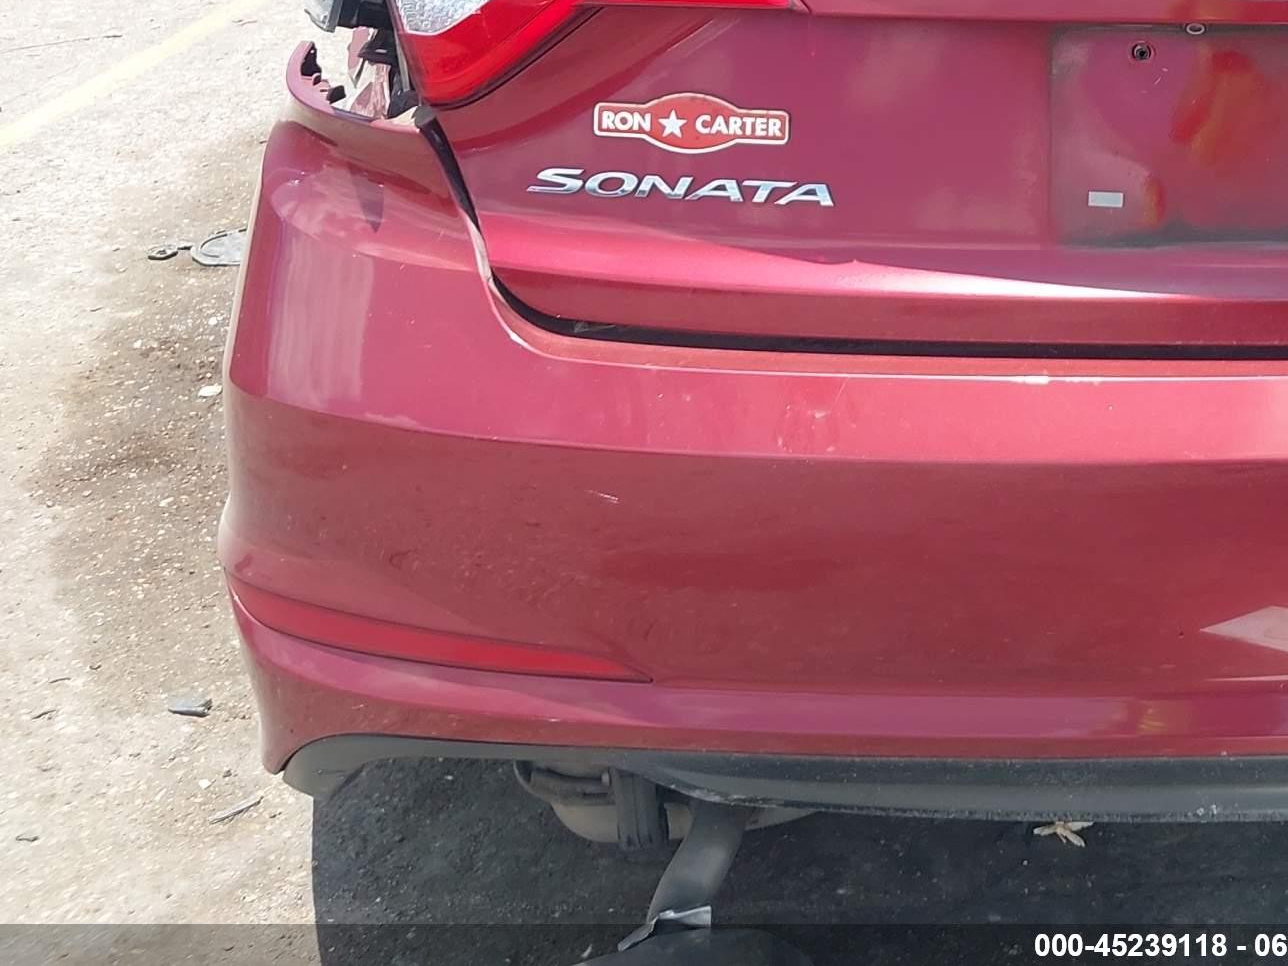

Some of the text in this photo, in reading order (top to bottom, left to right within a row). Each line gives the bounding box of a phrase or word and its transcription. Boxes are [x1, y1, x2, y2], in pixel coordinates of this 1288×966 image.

[601, 110, 784, 137] RON CARTER
[526, 167, 835, 207] SONATA
